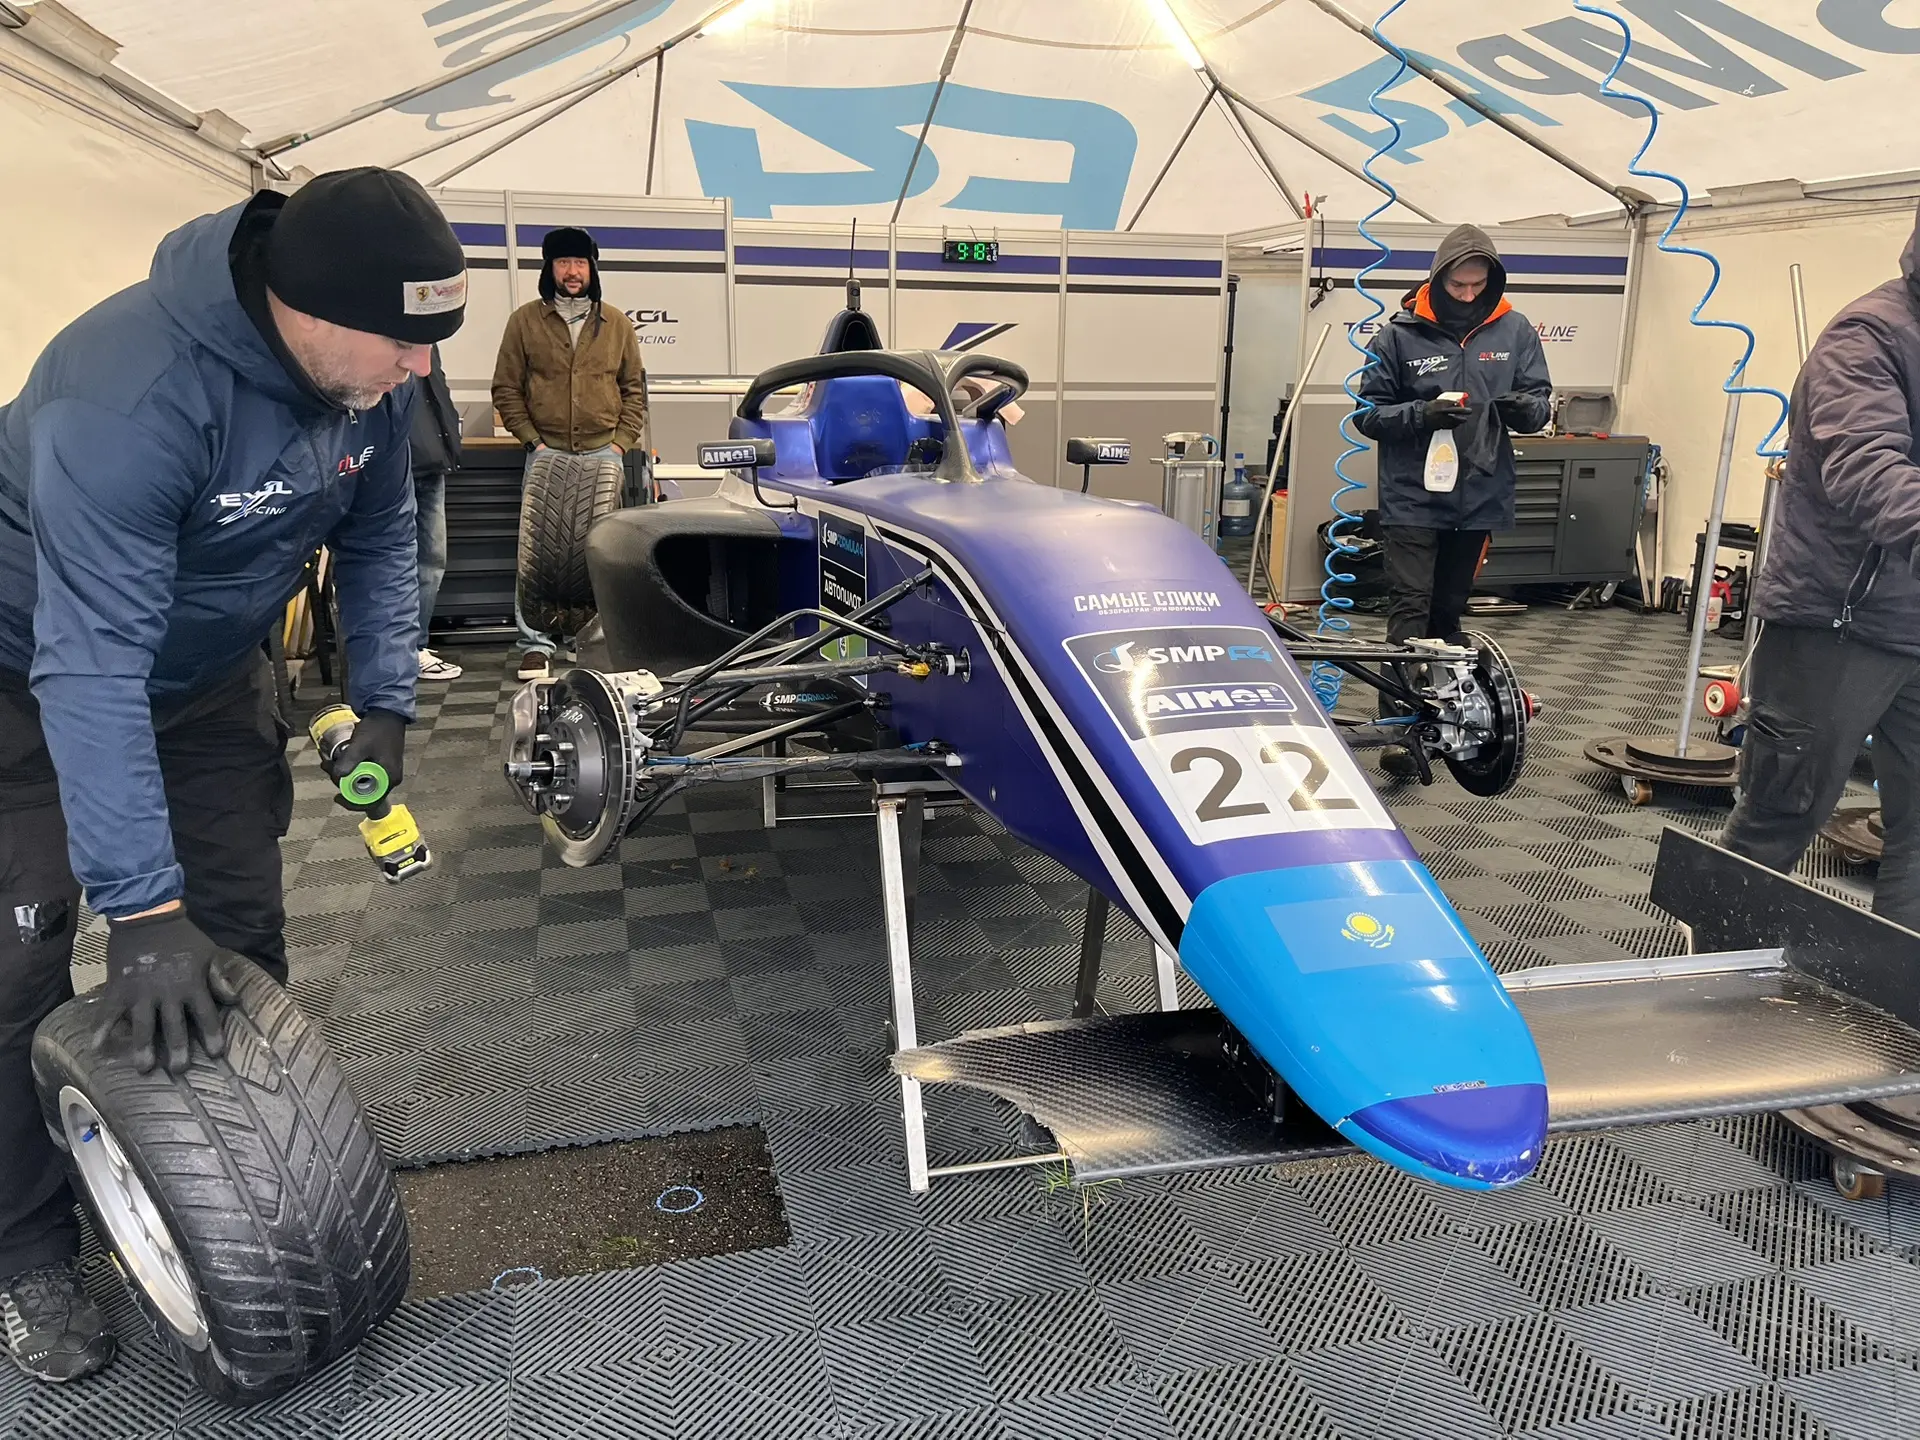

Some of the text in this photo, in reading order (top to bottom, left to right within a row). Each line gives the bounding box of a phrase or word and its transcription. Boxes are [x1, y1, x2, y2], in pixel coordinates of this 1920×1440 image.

[957, 242, 986, 261] 9:18
[636, 335, 676, 345] ACING
[1074, 591, 1222, 612] САМЫЕ СЛИКИ
[1170, 741, 1361, 823] 22
